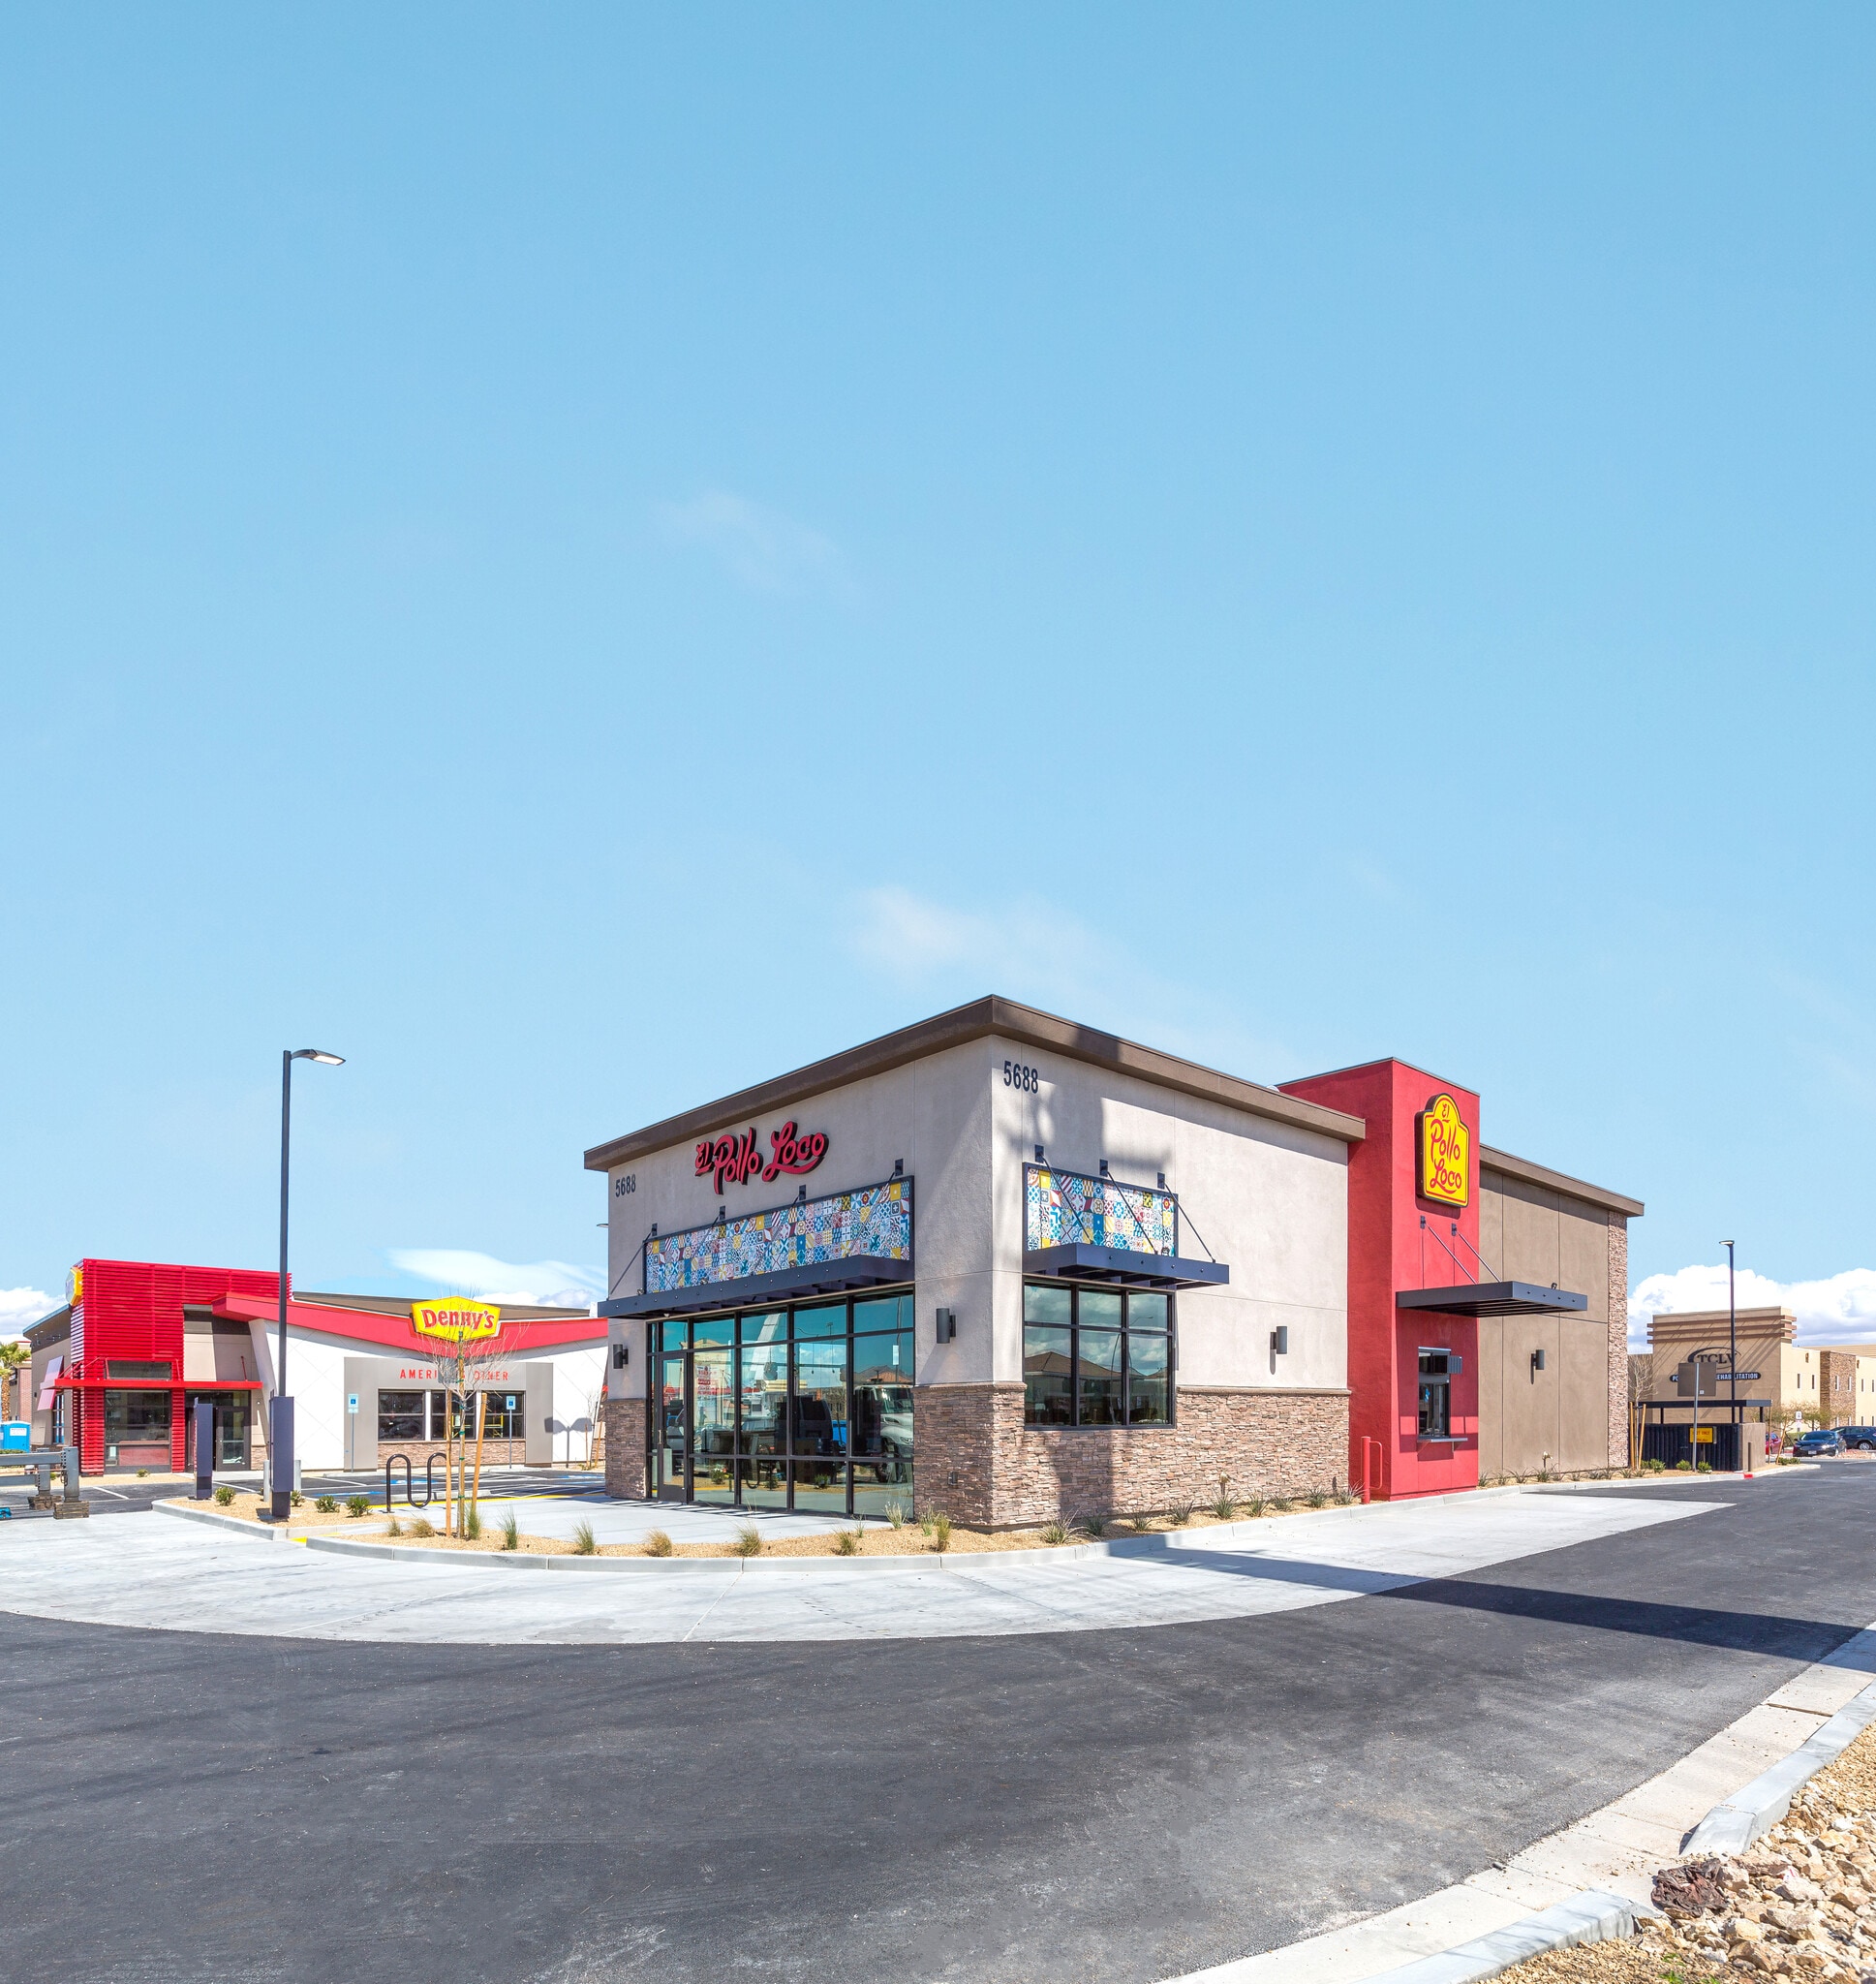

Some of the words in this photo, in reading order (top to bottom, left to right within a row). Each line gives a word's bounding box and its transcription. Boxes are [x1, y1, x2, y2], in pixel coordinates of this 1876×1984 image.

[1003, 1060, 1038, 1094] 5688
[713, 1127, 762, 1194] Pollo
[761, 1121, 829, 1182] Loco
[1430, 1118, 1461, 1163] Pollo
[615, 1173, 636, 1197] 5688
[1430, 1158, 1462, 1194] Loco
[420, 1309, 495, 1330] Denny's
[474, 1370, 508, 1381] DINER
